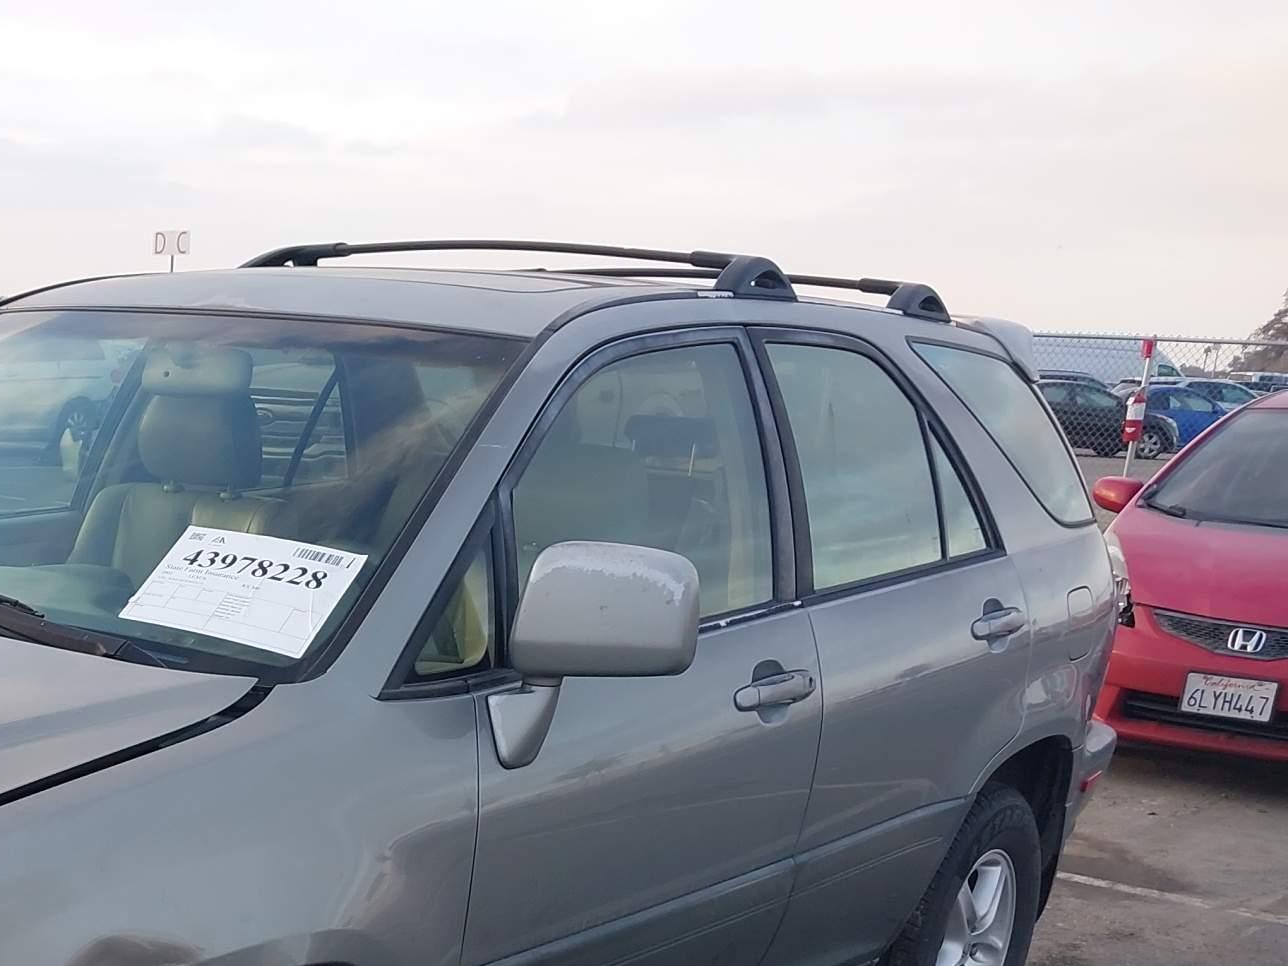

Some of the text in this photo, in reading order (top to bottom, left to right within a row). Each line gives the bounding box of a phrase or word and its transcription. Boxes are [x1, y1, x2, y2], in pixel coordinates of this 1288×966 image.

[154, 231, 187, 254] D C
[183, 549, 328, 590] 43978228
[1202, 675, 1260, 691] California
[1187, 688, 1270, 716] 6LYH447
